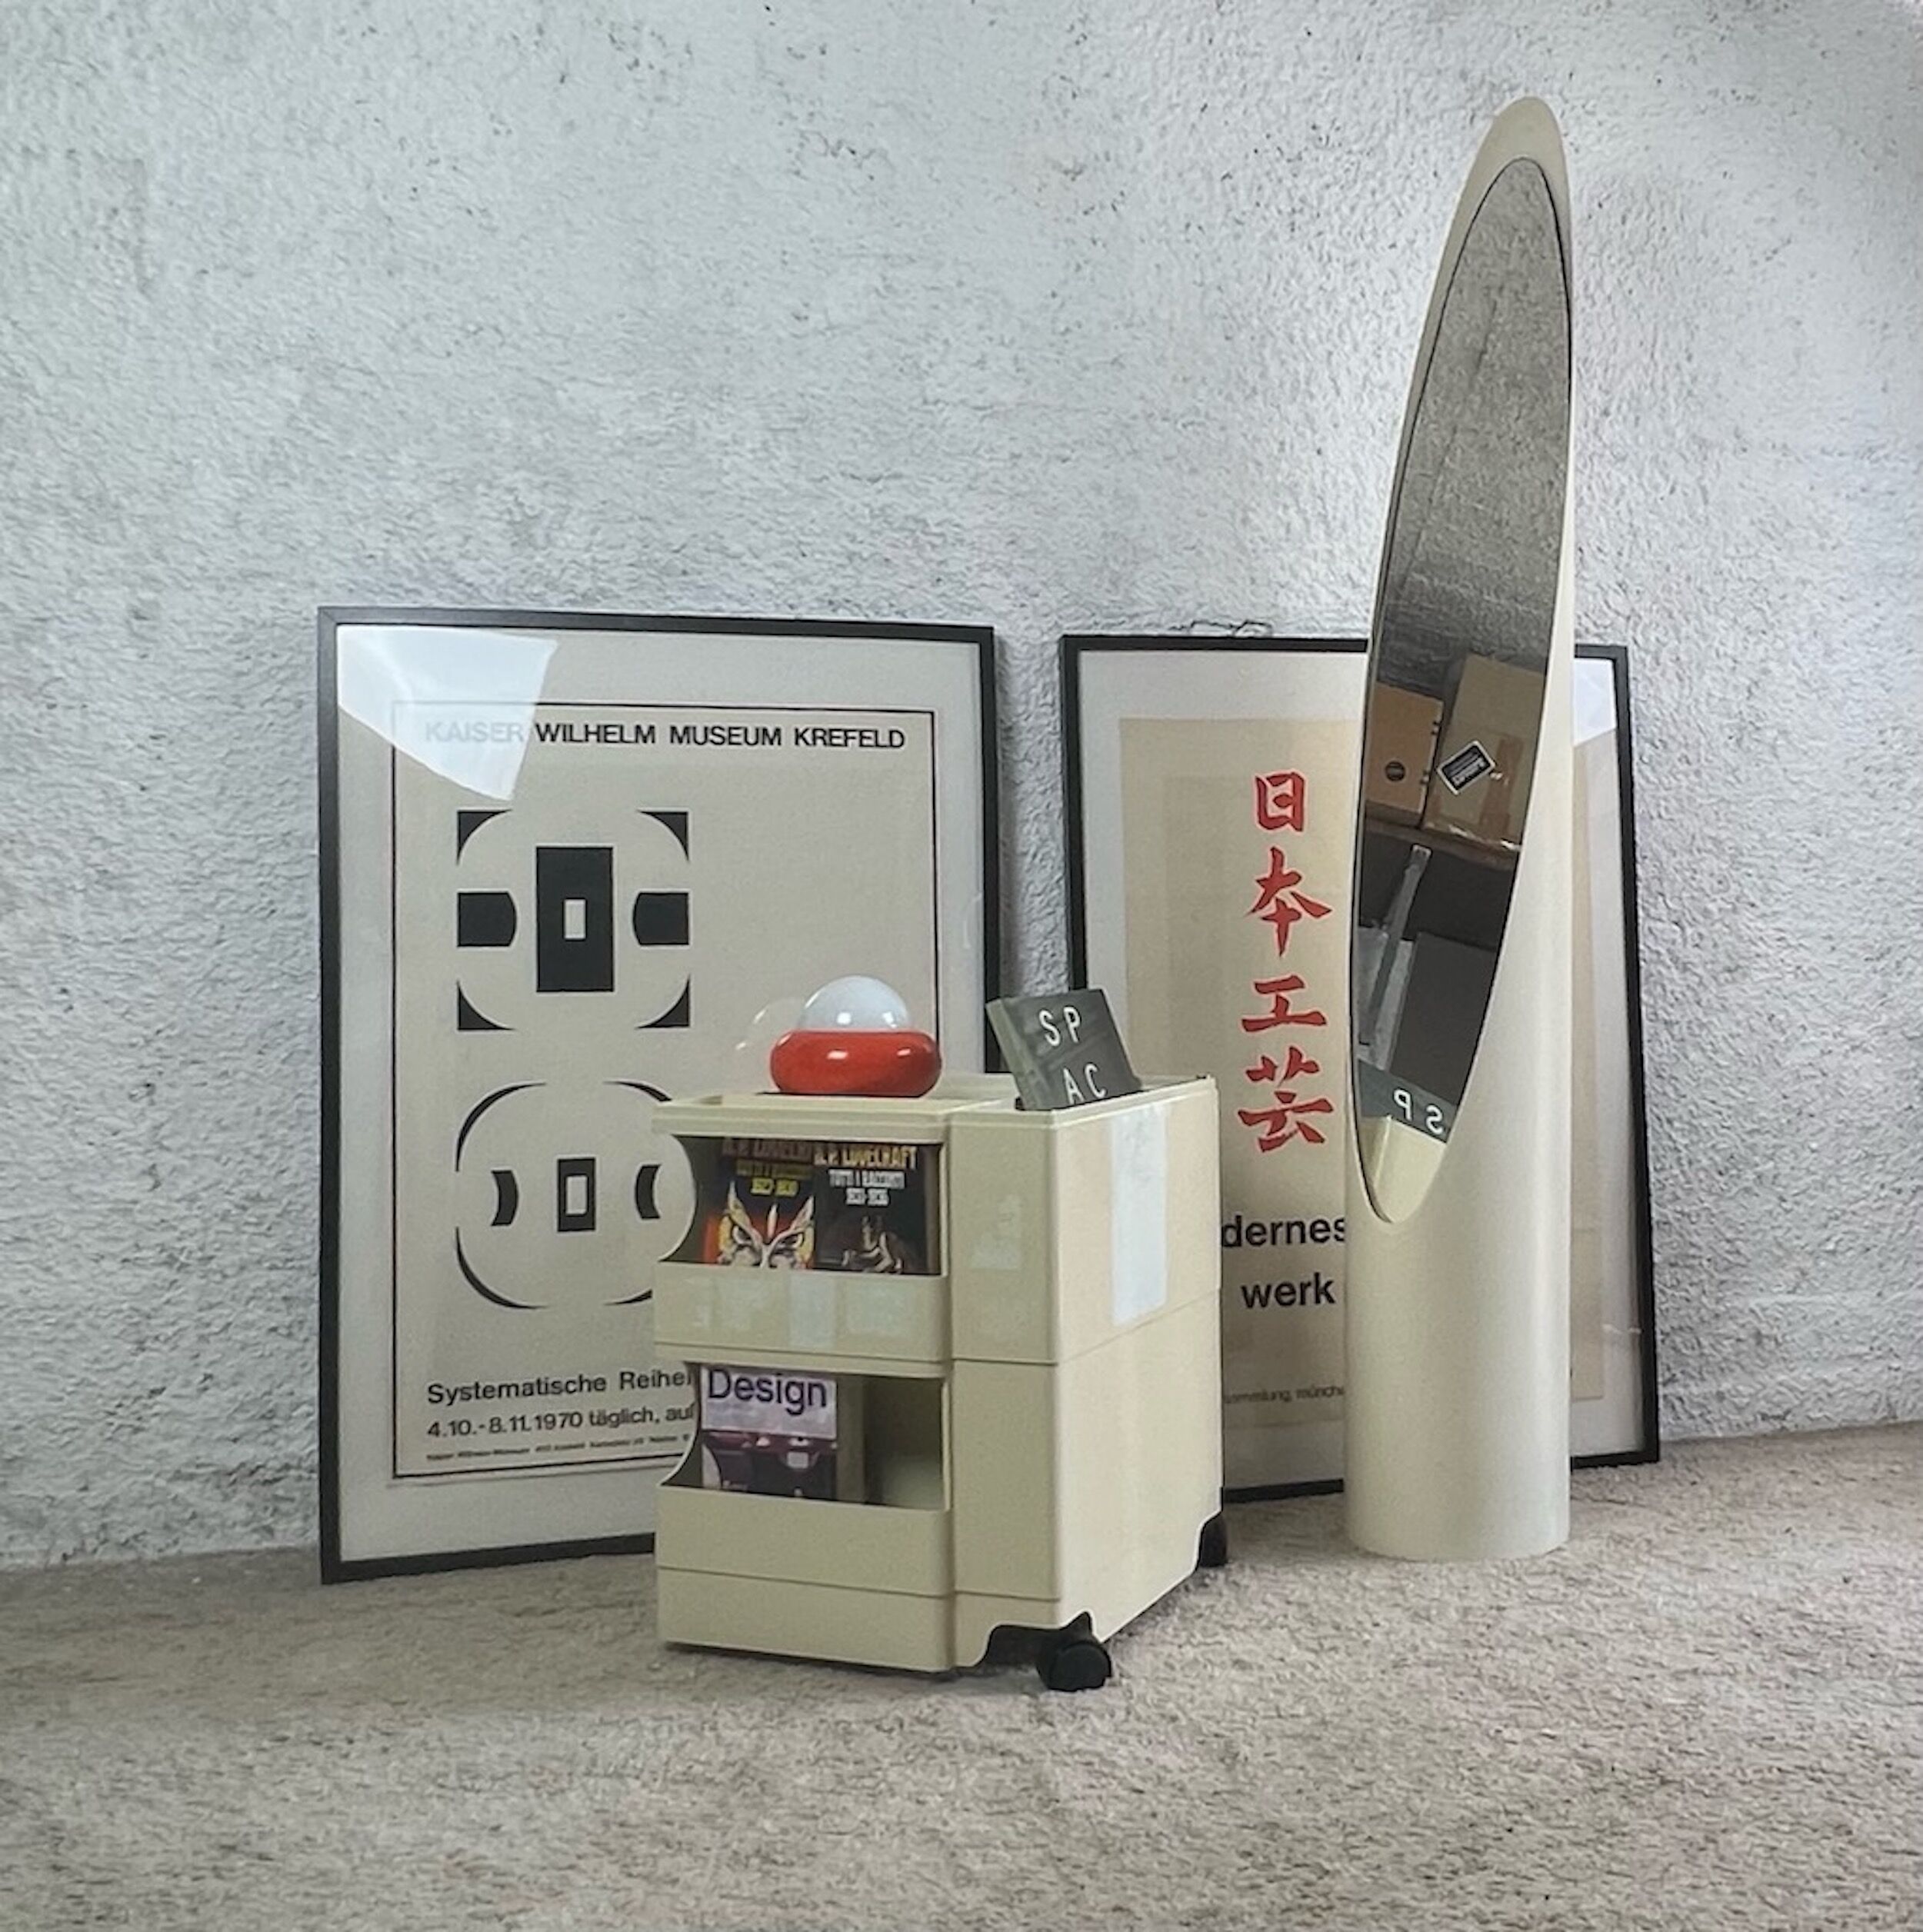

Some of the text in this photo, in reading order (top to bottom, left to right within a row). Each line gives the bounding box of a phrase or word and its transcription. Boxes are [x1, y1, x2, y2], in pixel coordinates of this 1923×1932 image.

[425, 721, 905, 748] KAISER WILHELM MUSEUM KREFELD
[1238, 770, 1335, 1152] 日本工芸
[1038, 1006, 1081, 1047] SP
[1061, 1063, 1108, 1105] AC
[1221, 1215, 1345, 1247] dernes
[1241, 1272, 1336, 1308] werk
[427, 1374, 606, 1406] Systematische
[708, 1369, 826, 1415] Design
